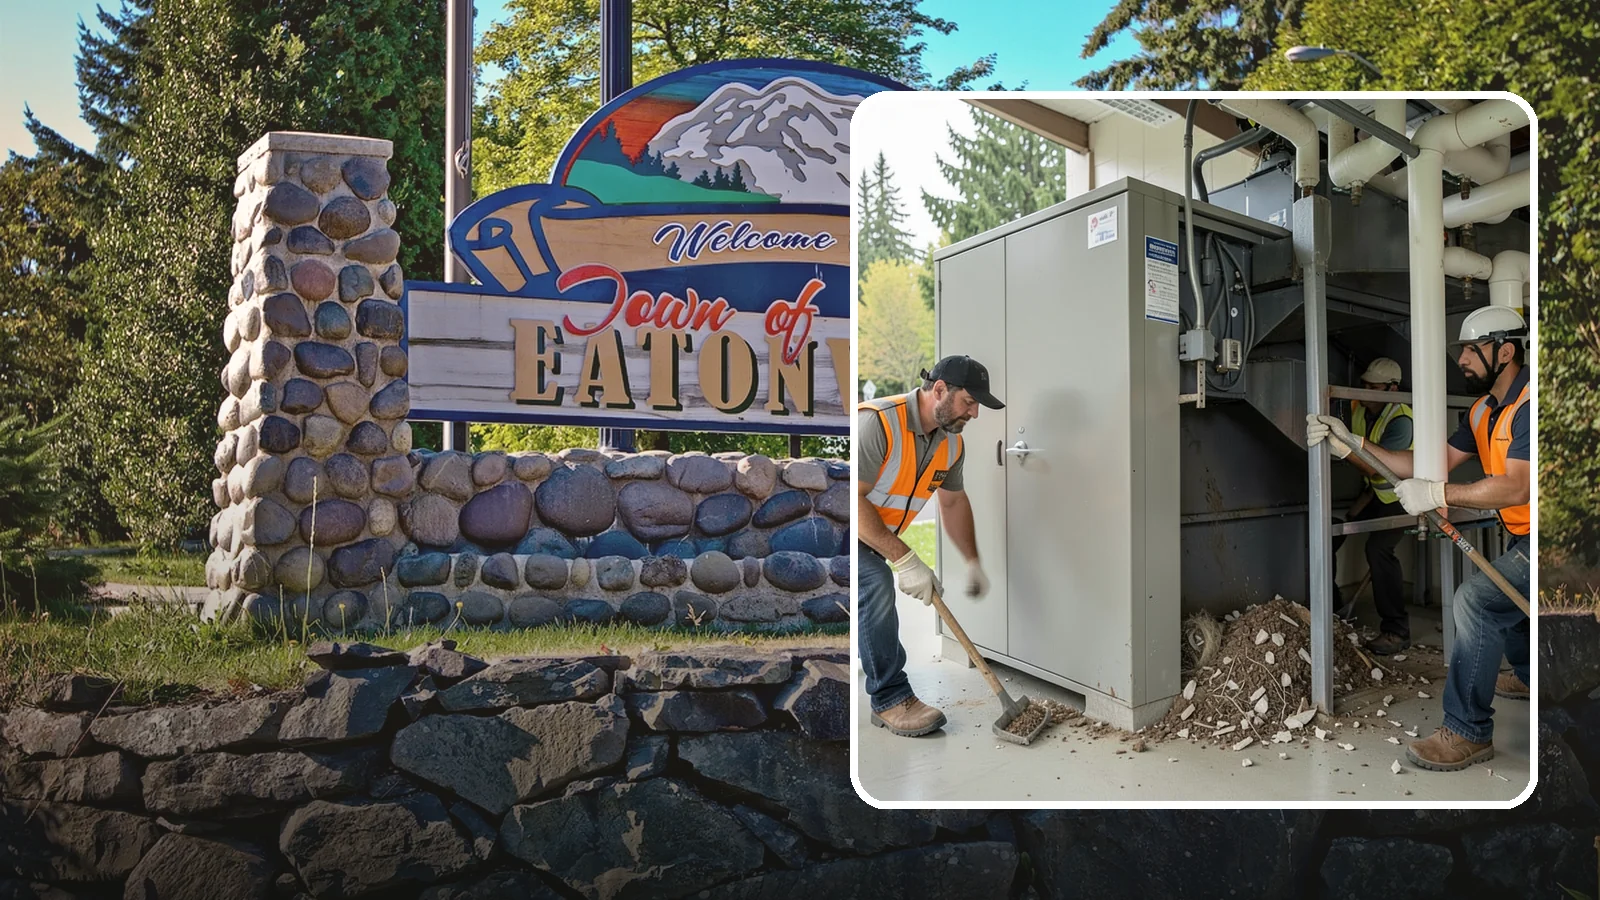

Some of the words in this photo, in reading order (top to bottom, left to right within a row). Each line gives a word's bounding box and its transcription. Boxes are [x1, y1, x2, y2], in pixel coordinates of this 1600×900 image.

[653, 220, 837, 263] Welcome
[556, 263, 738, 336] Town
[765, 279, 825, 366] of
